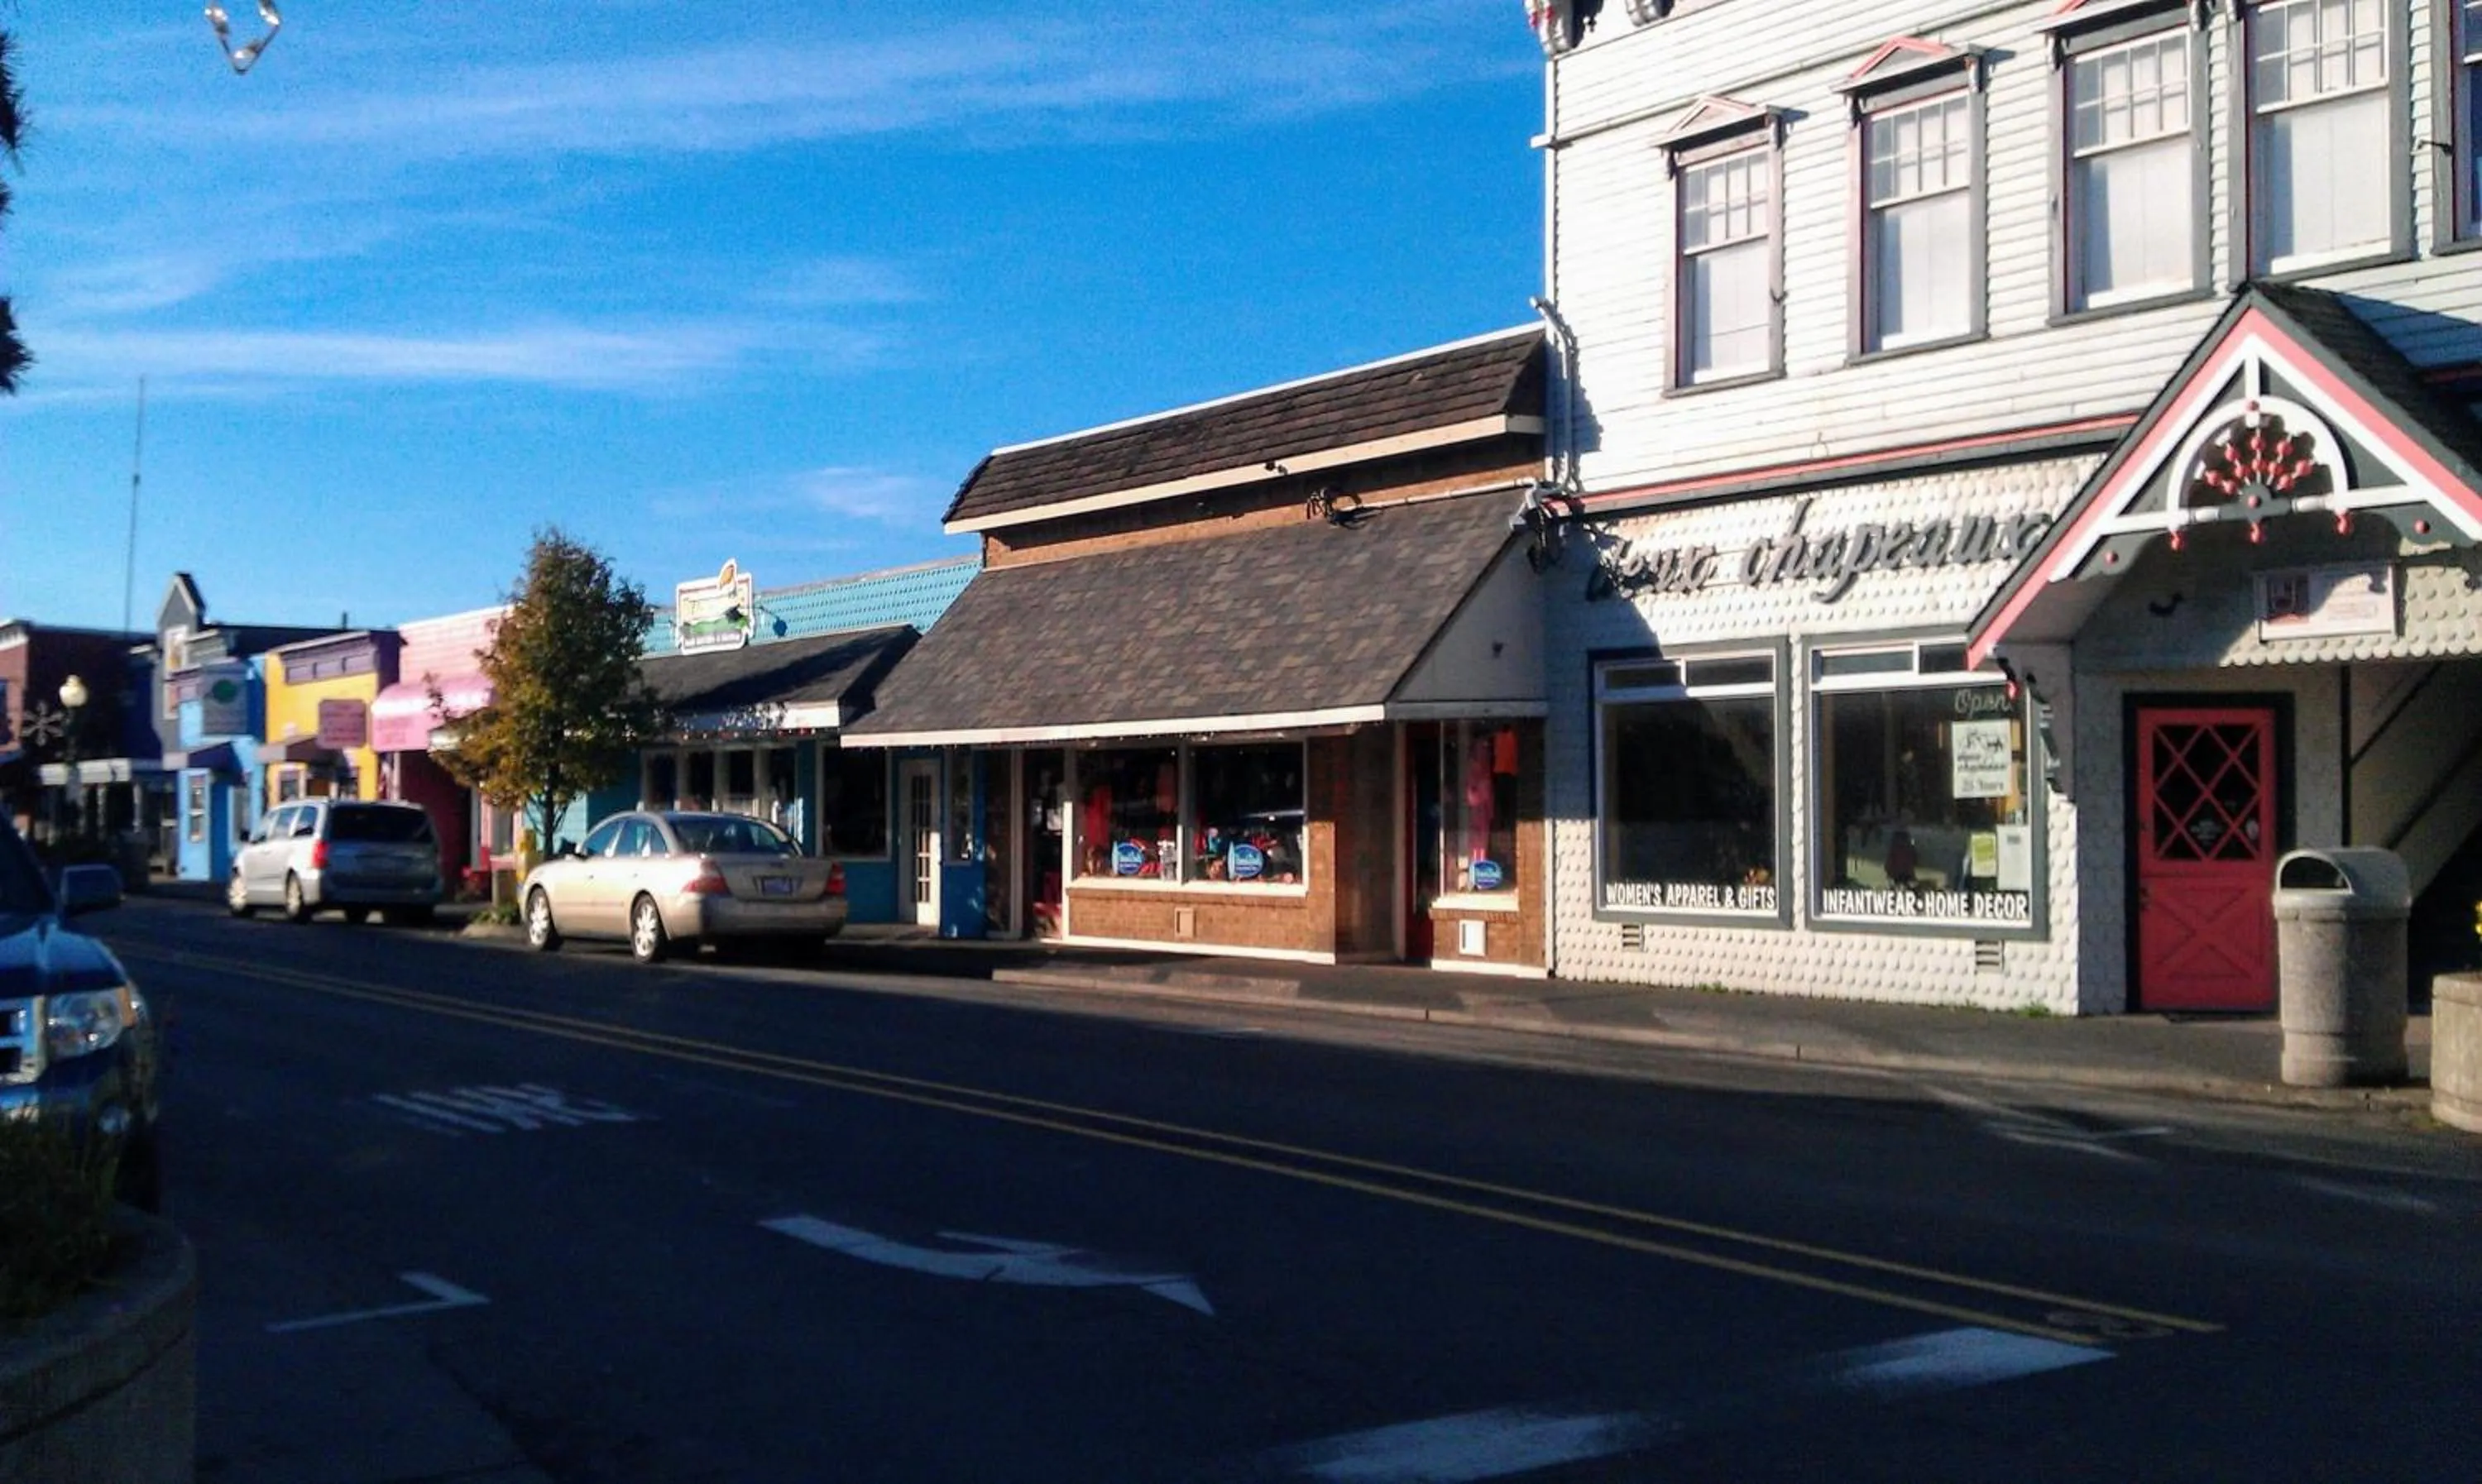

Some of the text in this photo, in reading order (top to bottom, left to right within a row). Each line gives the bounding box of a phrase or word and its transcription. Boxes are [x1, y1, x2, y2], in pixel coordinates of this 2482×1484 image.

[1740, 496, 2053, 605] chapeaux
[1954, 687, 2014, 719] Open
[1606, 883, 1775, 910] WOMEN'S APPAREL & GIFTS
[1823, 888, 1916, 916] INFANTWEAR
[1924, 890, 1969, 917] HOME
